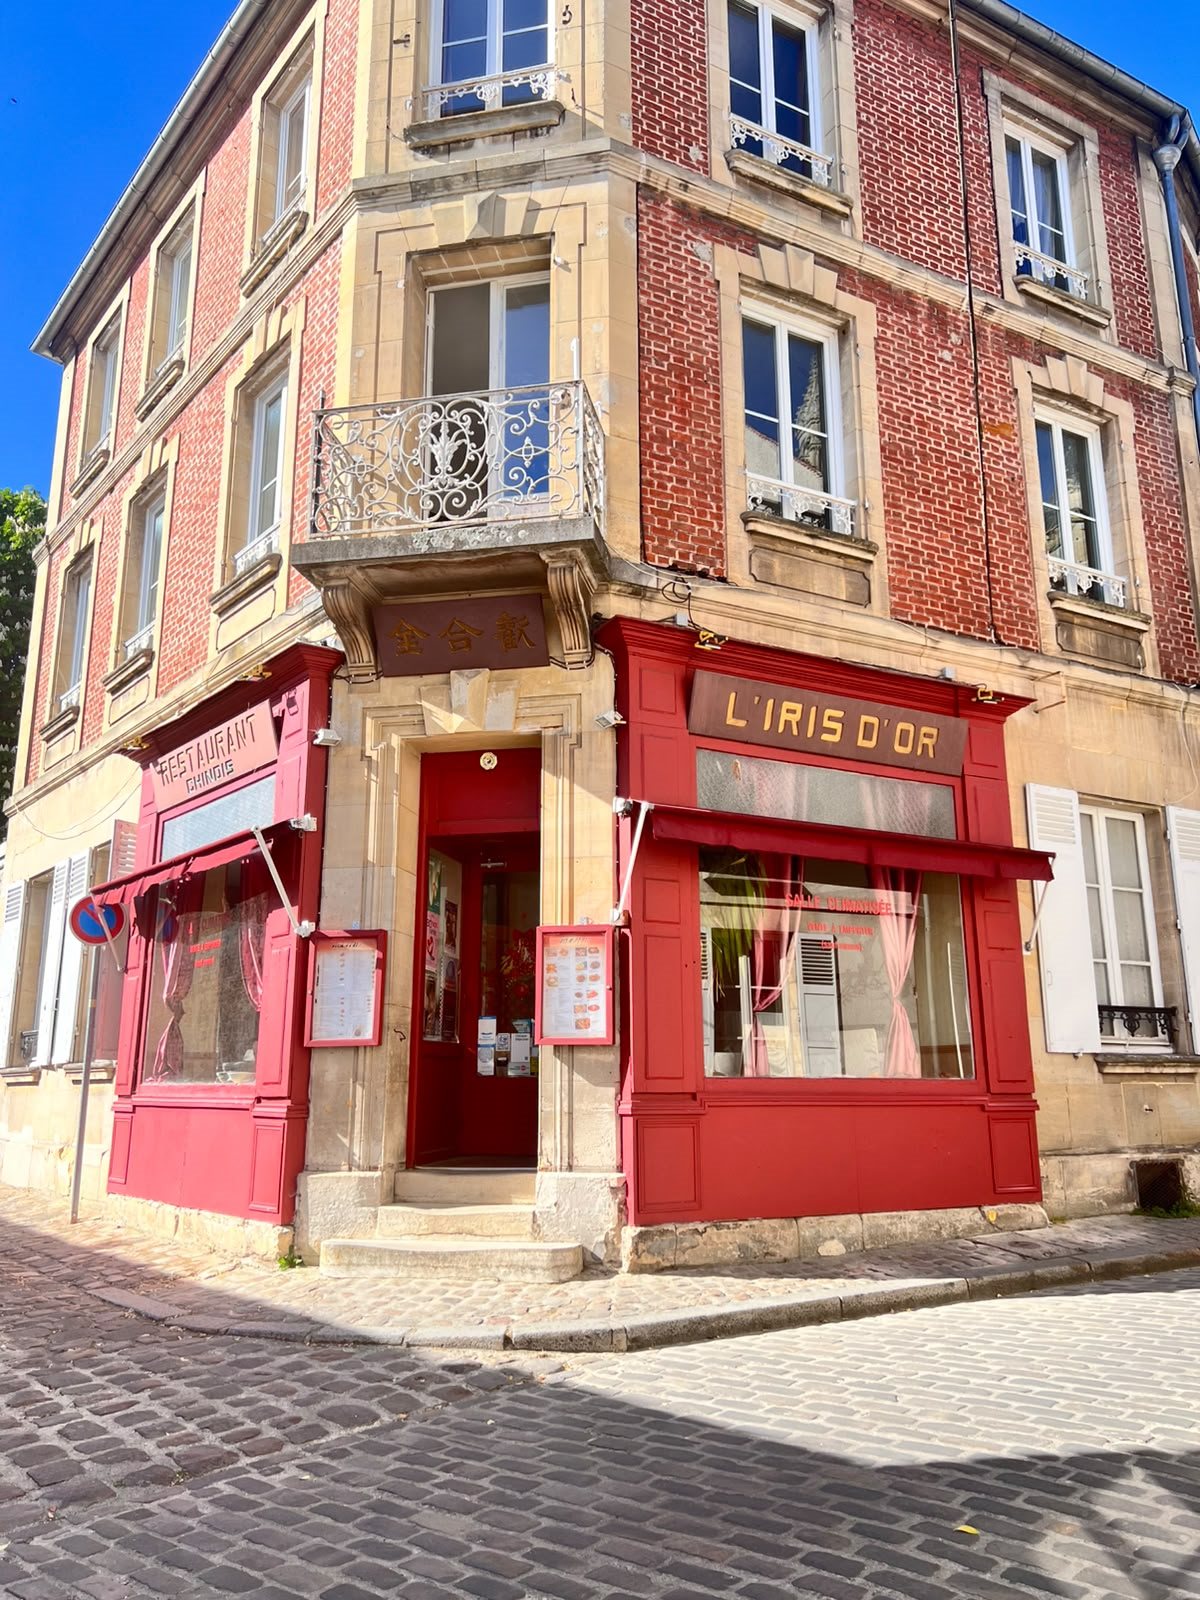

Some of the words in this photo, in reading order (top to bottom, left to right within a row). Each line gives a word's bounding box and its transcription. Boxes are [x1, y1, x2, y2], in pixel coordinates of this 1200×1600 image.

[159, 713, 255, 787] RESTAURANT
[726, 691, 846, 743] L'IRIS
[857, 714, 939, 759] D'OR
[185, 758, 235, 794] CHINOIS
[784, 893, 820, 909] SALLE
